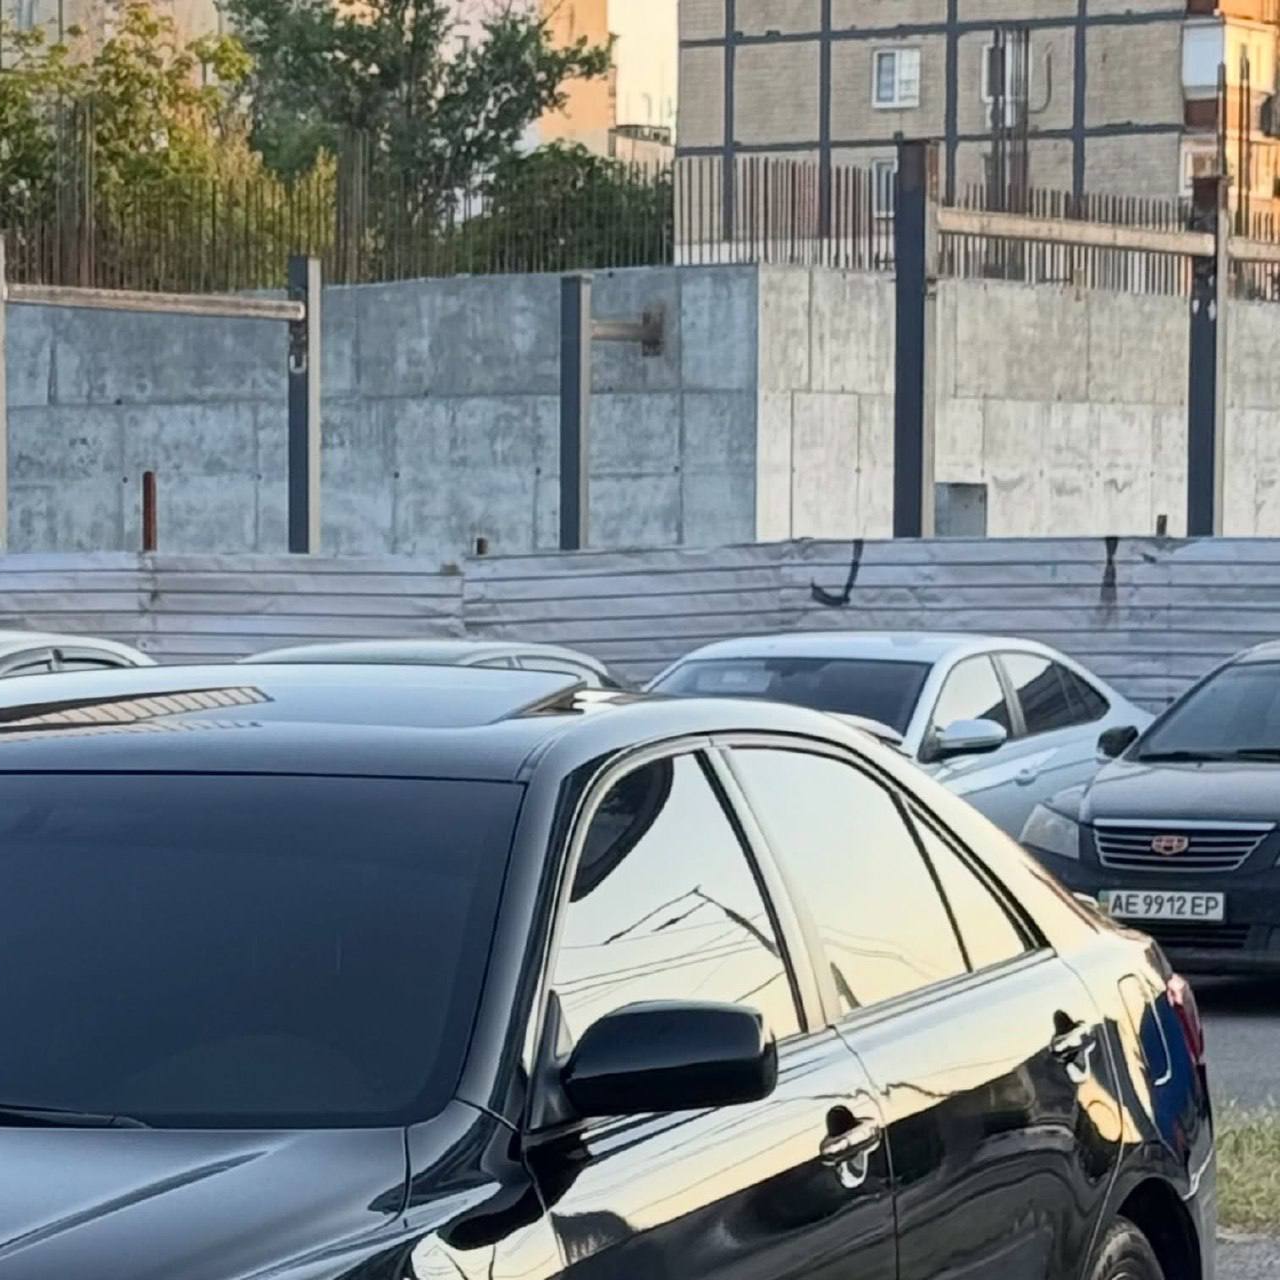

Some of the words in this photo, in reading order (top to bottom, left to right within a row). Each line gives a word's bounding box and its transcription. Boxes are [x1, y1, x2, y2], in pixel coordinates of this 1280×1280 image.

[1111, 893, 1140, 915] AE
[1142, 894, 1187, 916] 9912
[1190, 896, 1219, 916] EP
